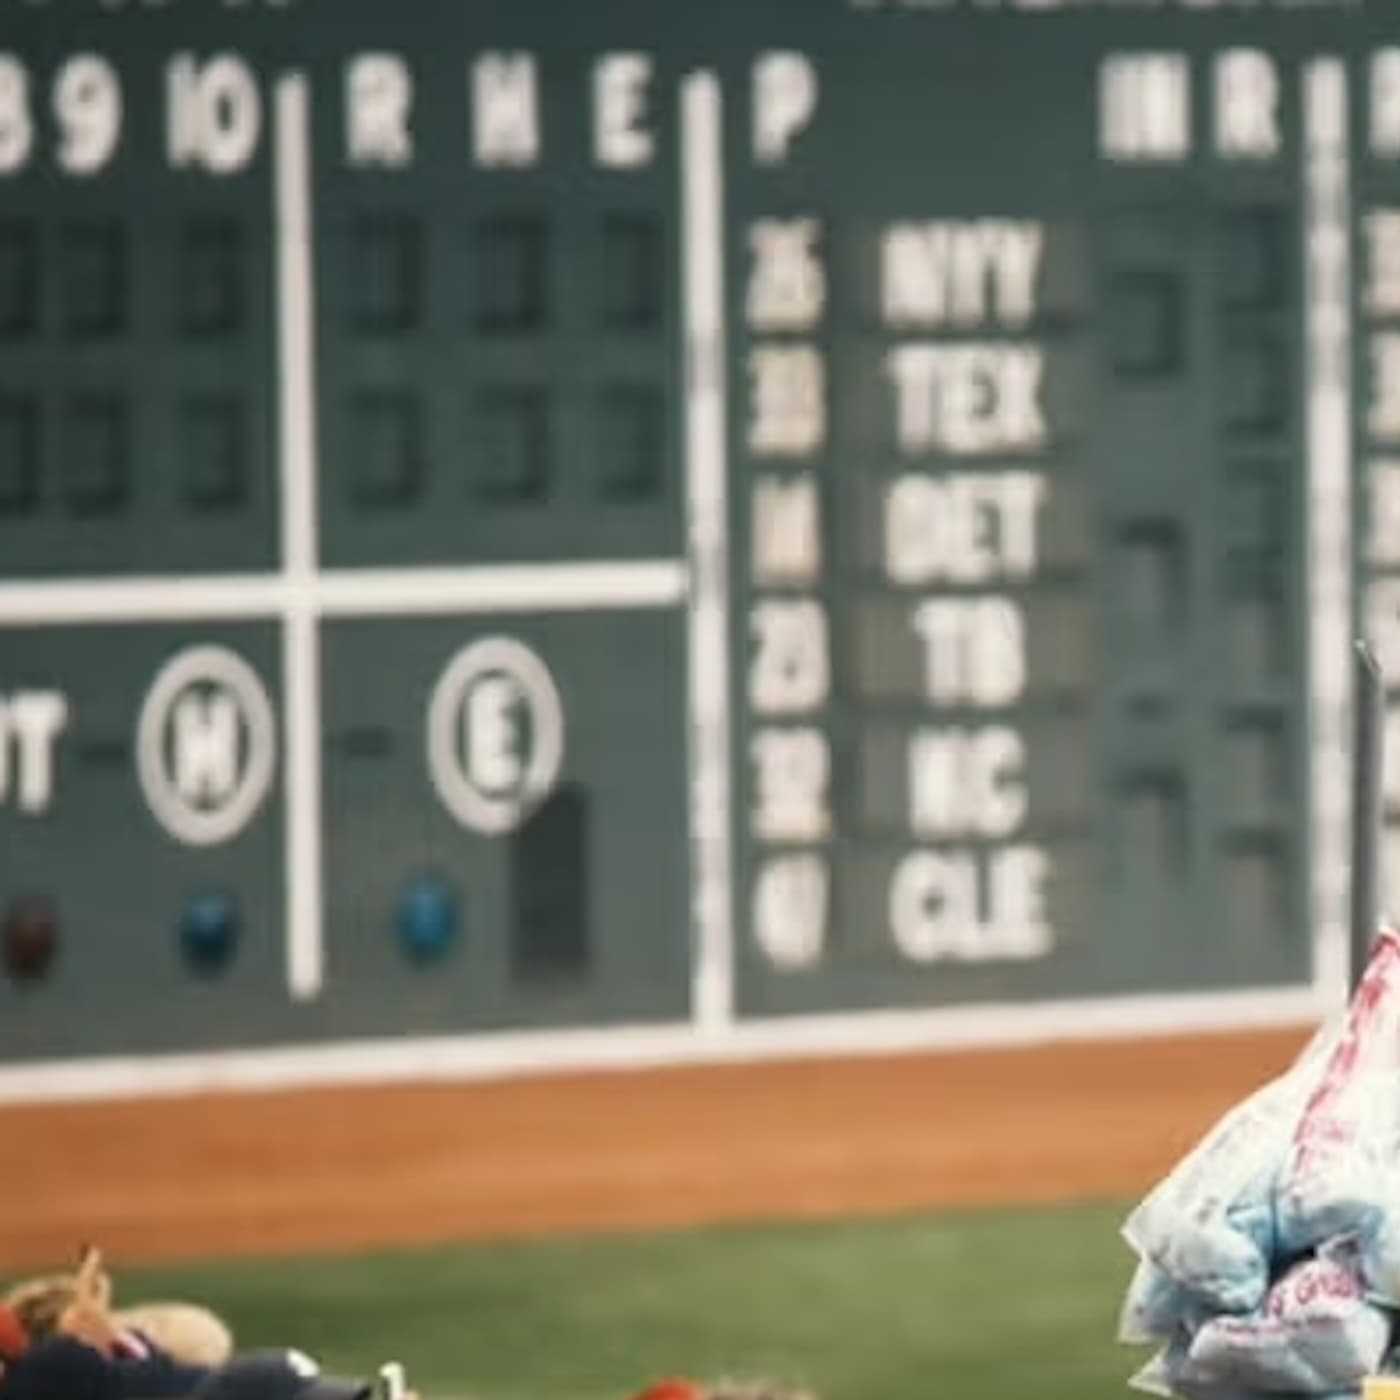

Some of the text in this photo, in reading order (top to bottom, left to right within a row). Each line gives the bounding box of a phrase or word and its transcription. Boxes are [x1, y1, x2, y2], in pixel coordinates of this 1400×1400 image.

[54, 56, 121, 172] 9
[167, 55, 260, 173] 10
[346, 53, 411, 163] R
[594, 53, 652, 168] E
[752, 51, 816, 156] P
[1213, 47, 1281, 156] R
[879, 218, 1044, 326] NYY
[884, 340, 1048, 457] TEX
[881, 467, 1049, 588] DET
[908, 592, 1031, 711] TB
[464, 674, 525, 796] E
[904, 721, 1031, 842] KC
[884, 841, 1057, 966] CLE
